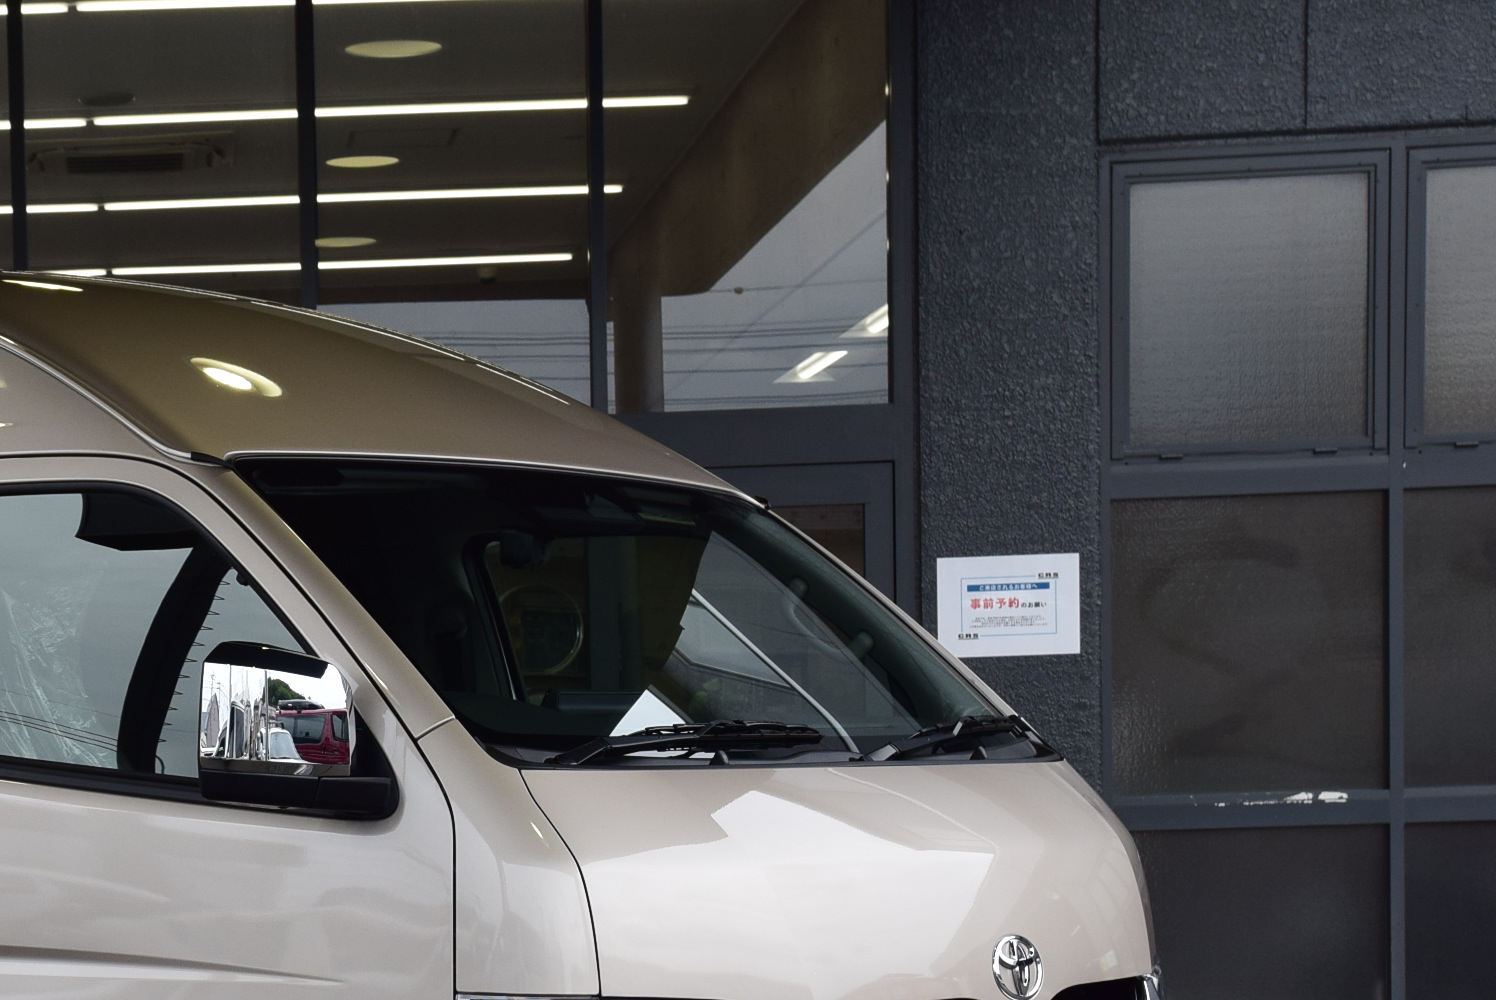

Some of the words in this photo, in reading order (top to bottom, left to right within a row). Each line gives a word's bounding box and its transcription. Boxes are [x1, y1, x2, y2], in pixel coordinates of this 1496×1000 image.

[970, 596, 1047, 610] 事前予約のお願い
